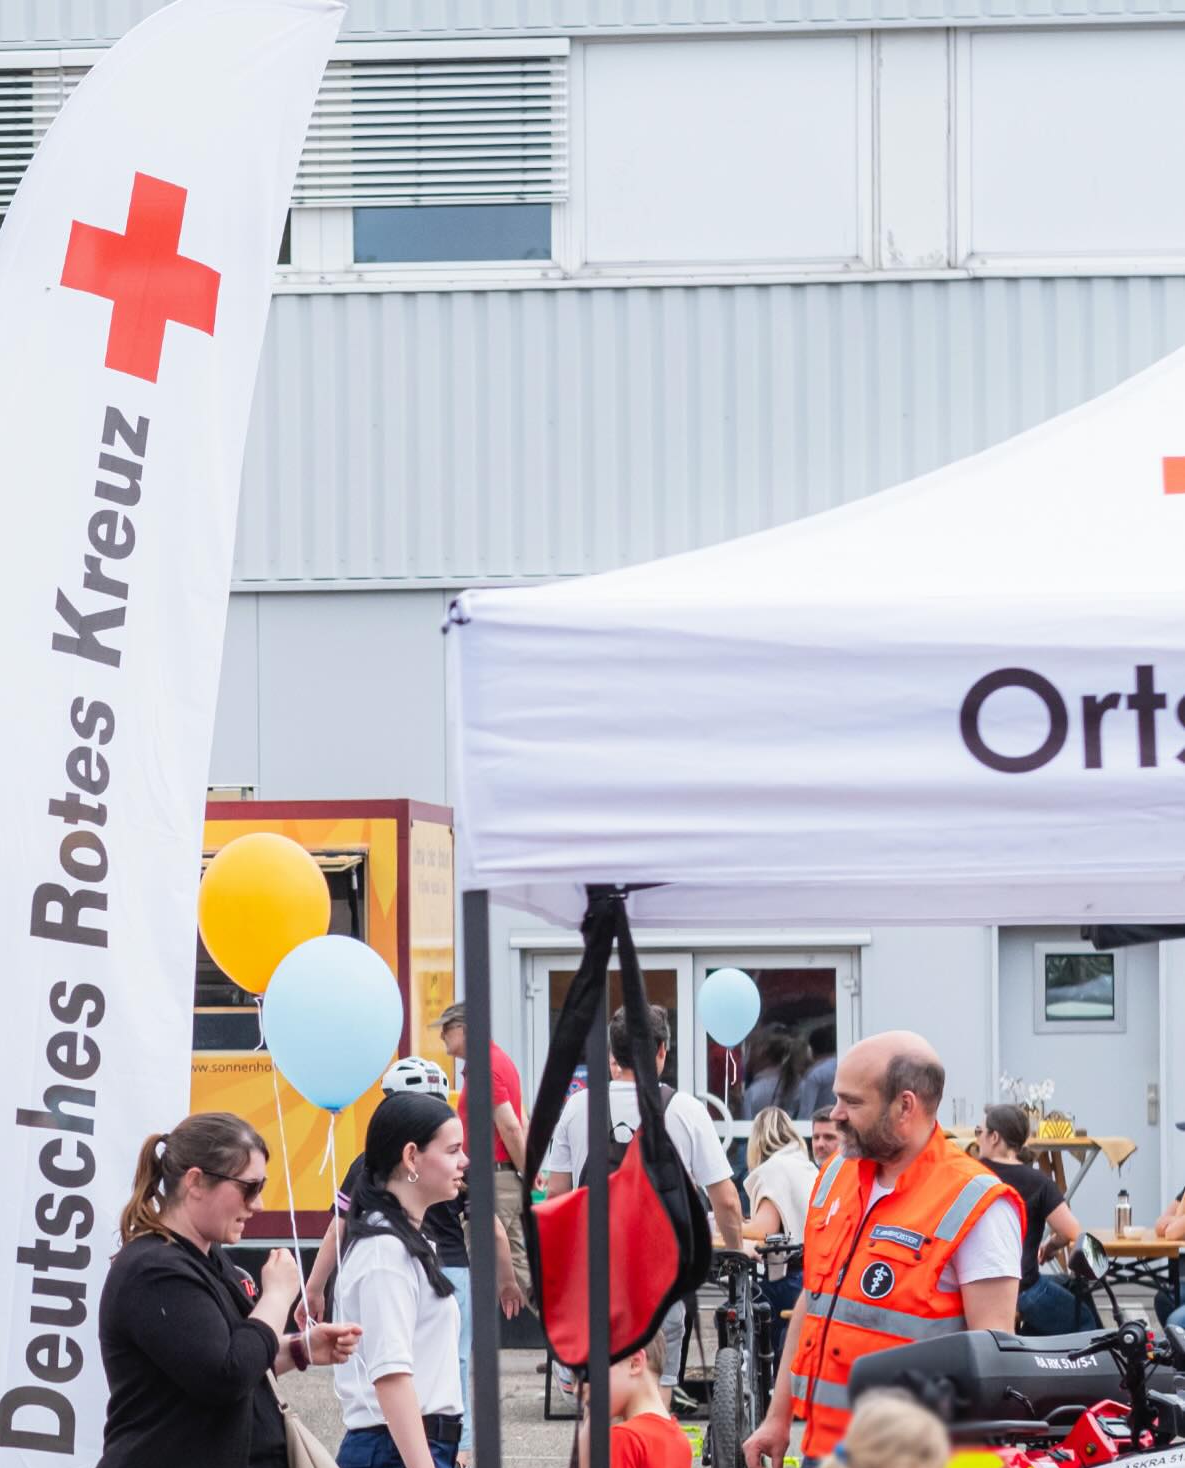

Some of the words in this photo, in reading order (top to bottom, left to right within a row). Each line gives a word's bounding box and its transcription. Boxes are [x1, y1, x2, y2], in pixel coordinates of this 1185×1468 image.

[51, 405, 151, 669] Kreuz
[29, 696, 116, 949] Rotes
[959, 664, 1185, 774] Ort
